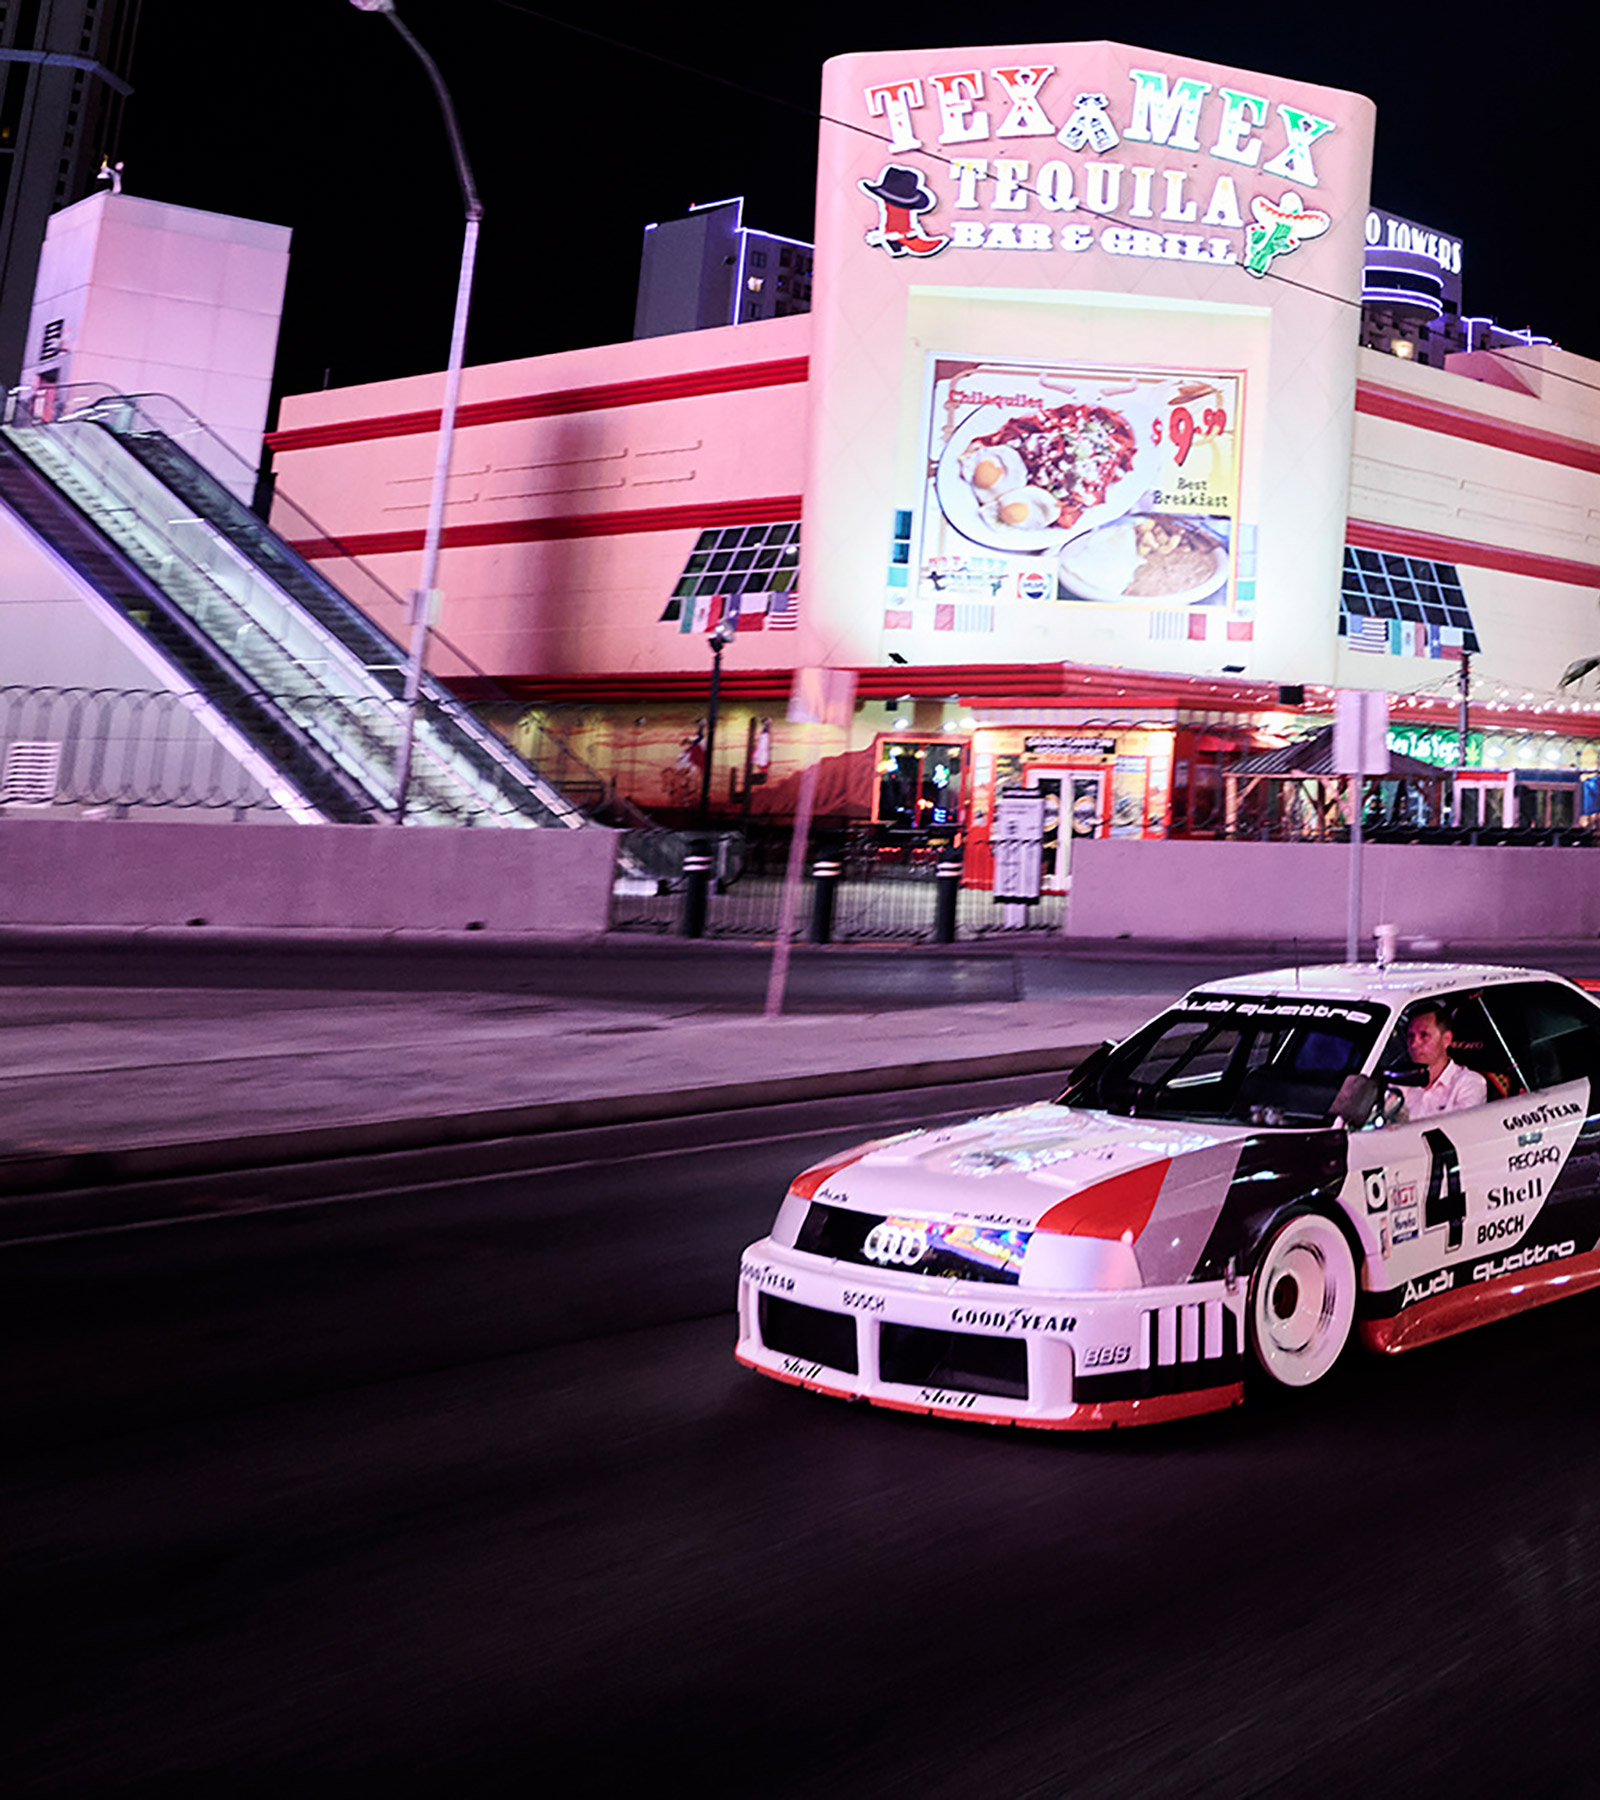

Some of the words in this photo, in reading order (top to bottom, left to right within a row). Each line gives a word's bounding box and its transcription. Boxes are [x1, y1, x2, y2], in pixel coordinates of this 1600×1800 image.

[864, 65, 1057, 155] TEX
[1122, 68, 1336, 188] MEX
[949, 157, 1245, 229] TEQUILA
[949, 219, 1054, 252] BAR
[1059, 225, 1094, 252] &
[1099, 227, 1238, 266] GRILL
[1386, 218, 1462, 274] TOWERS
[1152, 490, 1228, 507] Breakfast
[1177, 477, 1207, 491] Best
[1431, 734, 1461, 764] Vega
[1172, 999, 1235, 1013] Audi
[1236, 1002, 1372, 1025] quattro
[1503, 1103, 1582, 1131] GOODYEAR
[1508, 1146, 1561, 1172] RECARO
[1422, 1127, 1467, 1254] 4
[1487, 1178, 1542, 1210] Shell
[1477, 1215, 1525, 1245] BOSCH
[1401, 1270, 1454, 1308] Audi
[1473, 1240, 1576, 1282] quattro
[951, 1306, 1077, 1334] GOODYEAR
[781, 1357, 823, 1380] Shell
[1084, 1345, 1131, 1369] BBS
[916, 1388, 978, 1408] Shell
